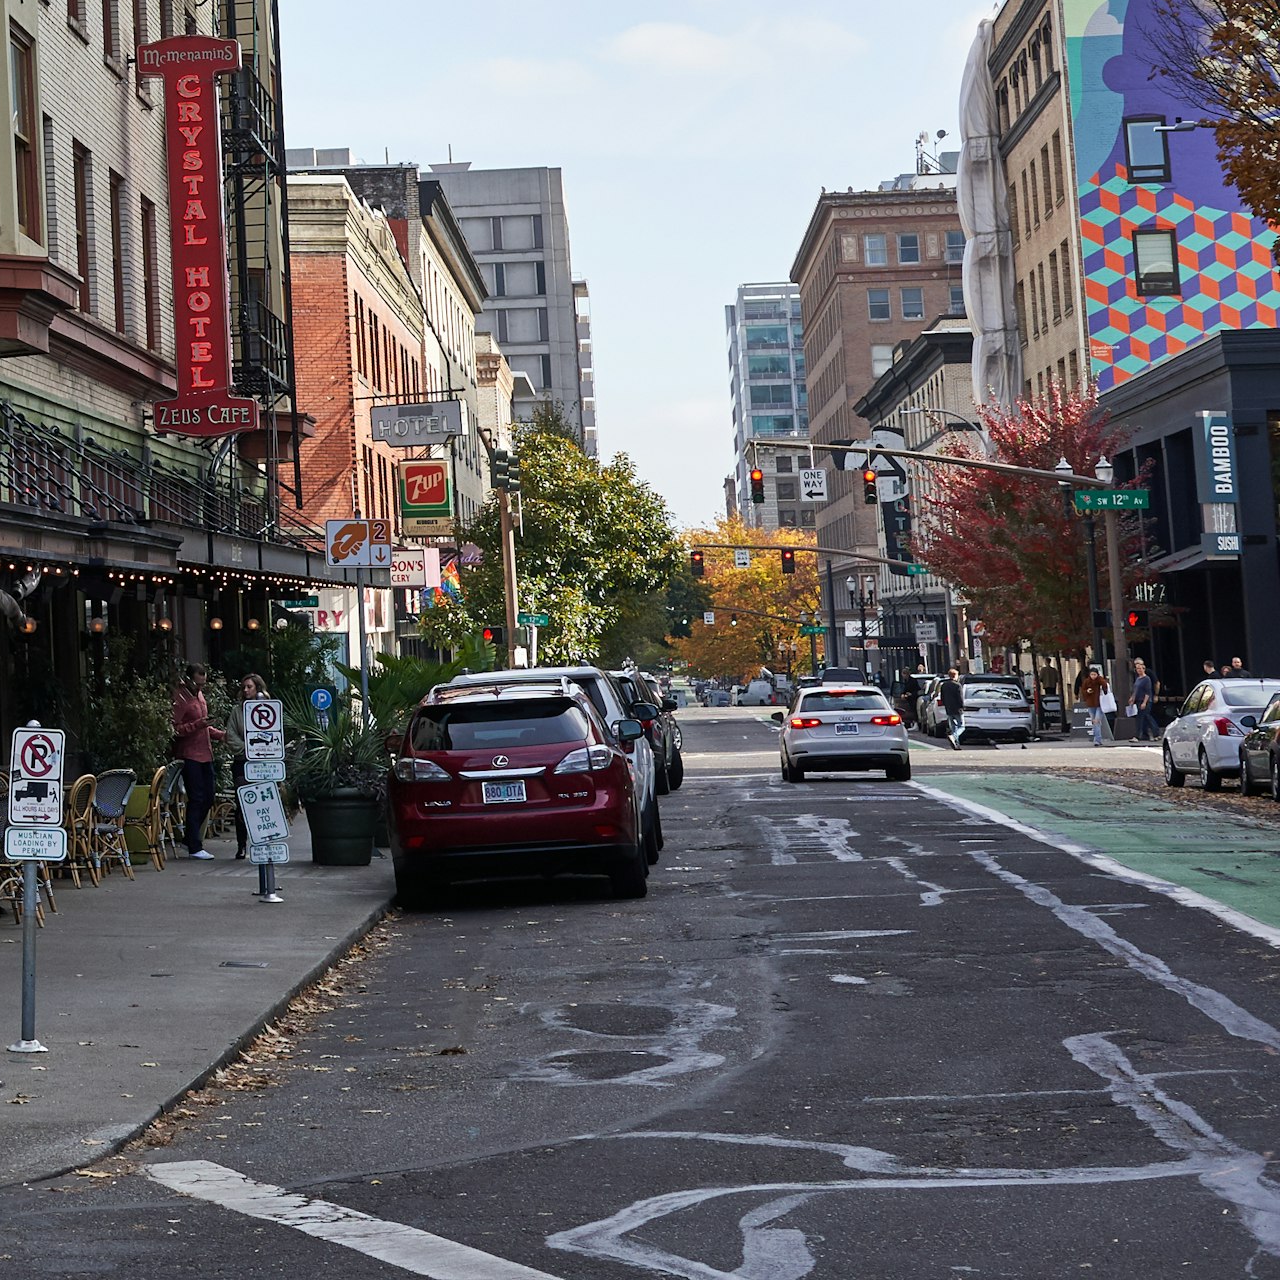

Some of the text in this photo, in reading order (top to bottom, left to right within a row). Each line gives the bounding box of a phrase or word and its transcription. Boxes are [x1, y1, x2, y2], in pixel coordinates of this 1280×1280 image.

[143, 45, 234, 67] McMenamins
[177, 74, 209, 247] CRYSTAL
[184, 266, 216, 389] HOTEL
[160, 404, 250, 425] ZEUS CAFE
[378, 415, 456, 437] HOTEL
[1210, 425, 1233, 494] BAMBOO
[803, 471, 822, 479] ONE
[407, 471, 442, 501] 7UP
[803, 480, 823, 488] WAY
[1097, 494, 1143, 505] SW 12th Av
[374, 523, 386, 540] 2
[1217, 536, 1239, 550] SUSHI
[391, 561, 423, 572] SON'S
[391, 575, 410, 583] CERY
[318, 610, 344, 627] RY
[256, 807, 270, 816] PAY
[259, 815, 271, 823] TO
[257, 821, 278, 831] PARK
